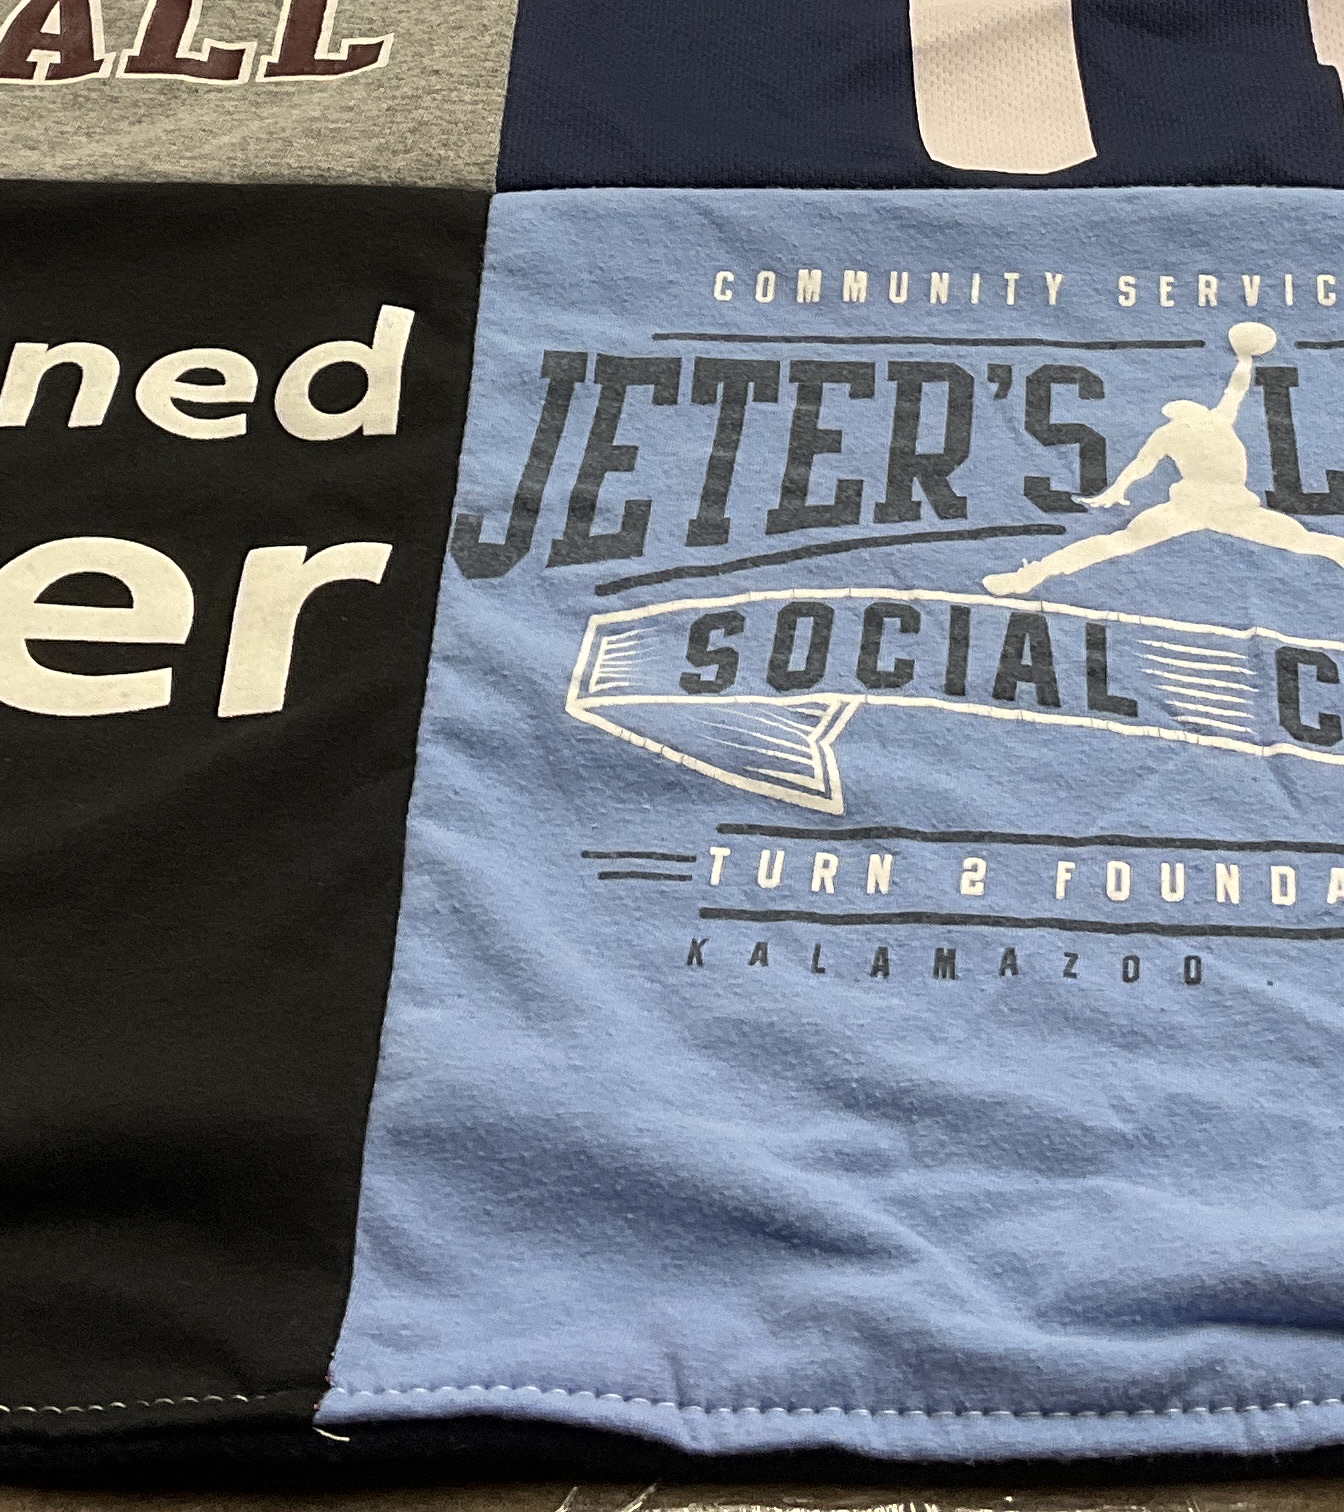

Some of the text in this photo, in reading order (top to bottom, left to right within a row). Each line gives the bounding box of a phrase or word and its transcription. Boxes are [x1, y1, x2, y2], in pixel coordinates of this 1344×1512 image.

[713, 269, 1064, 308] COMMUNITY
[449, 349, 1111, 580] JETER'S
[677, 599, 1139, 718] SOCIAL
[706, 845, 896, 893] TURN
[960, 856, 989, 897] 2
[685, 938, 1205, 987] KALAMAZOO
